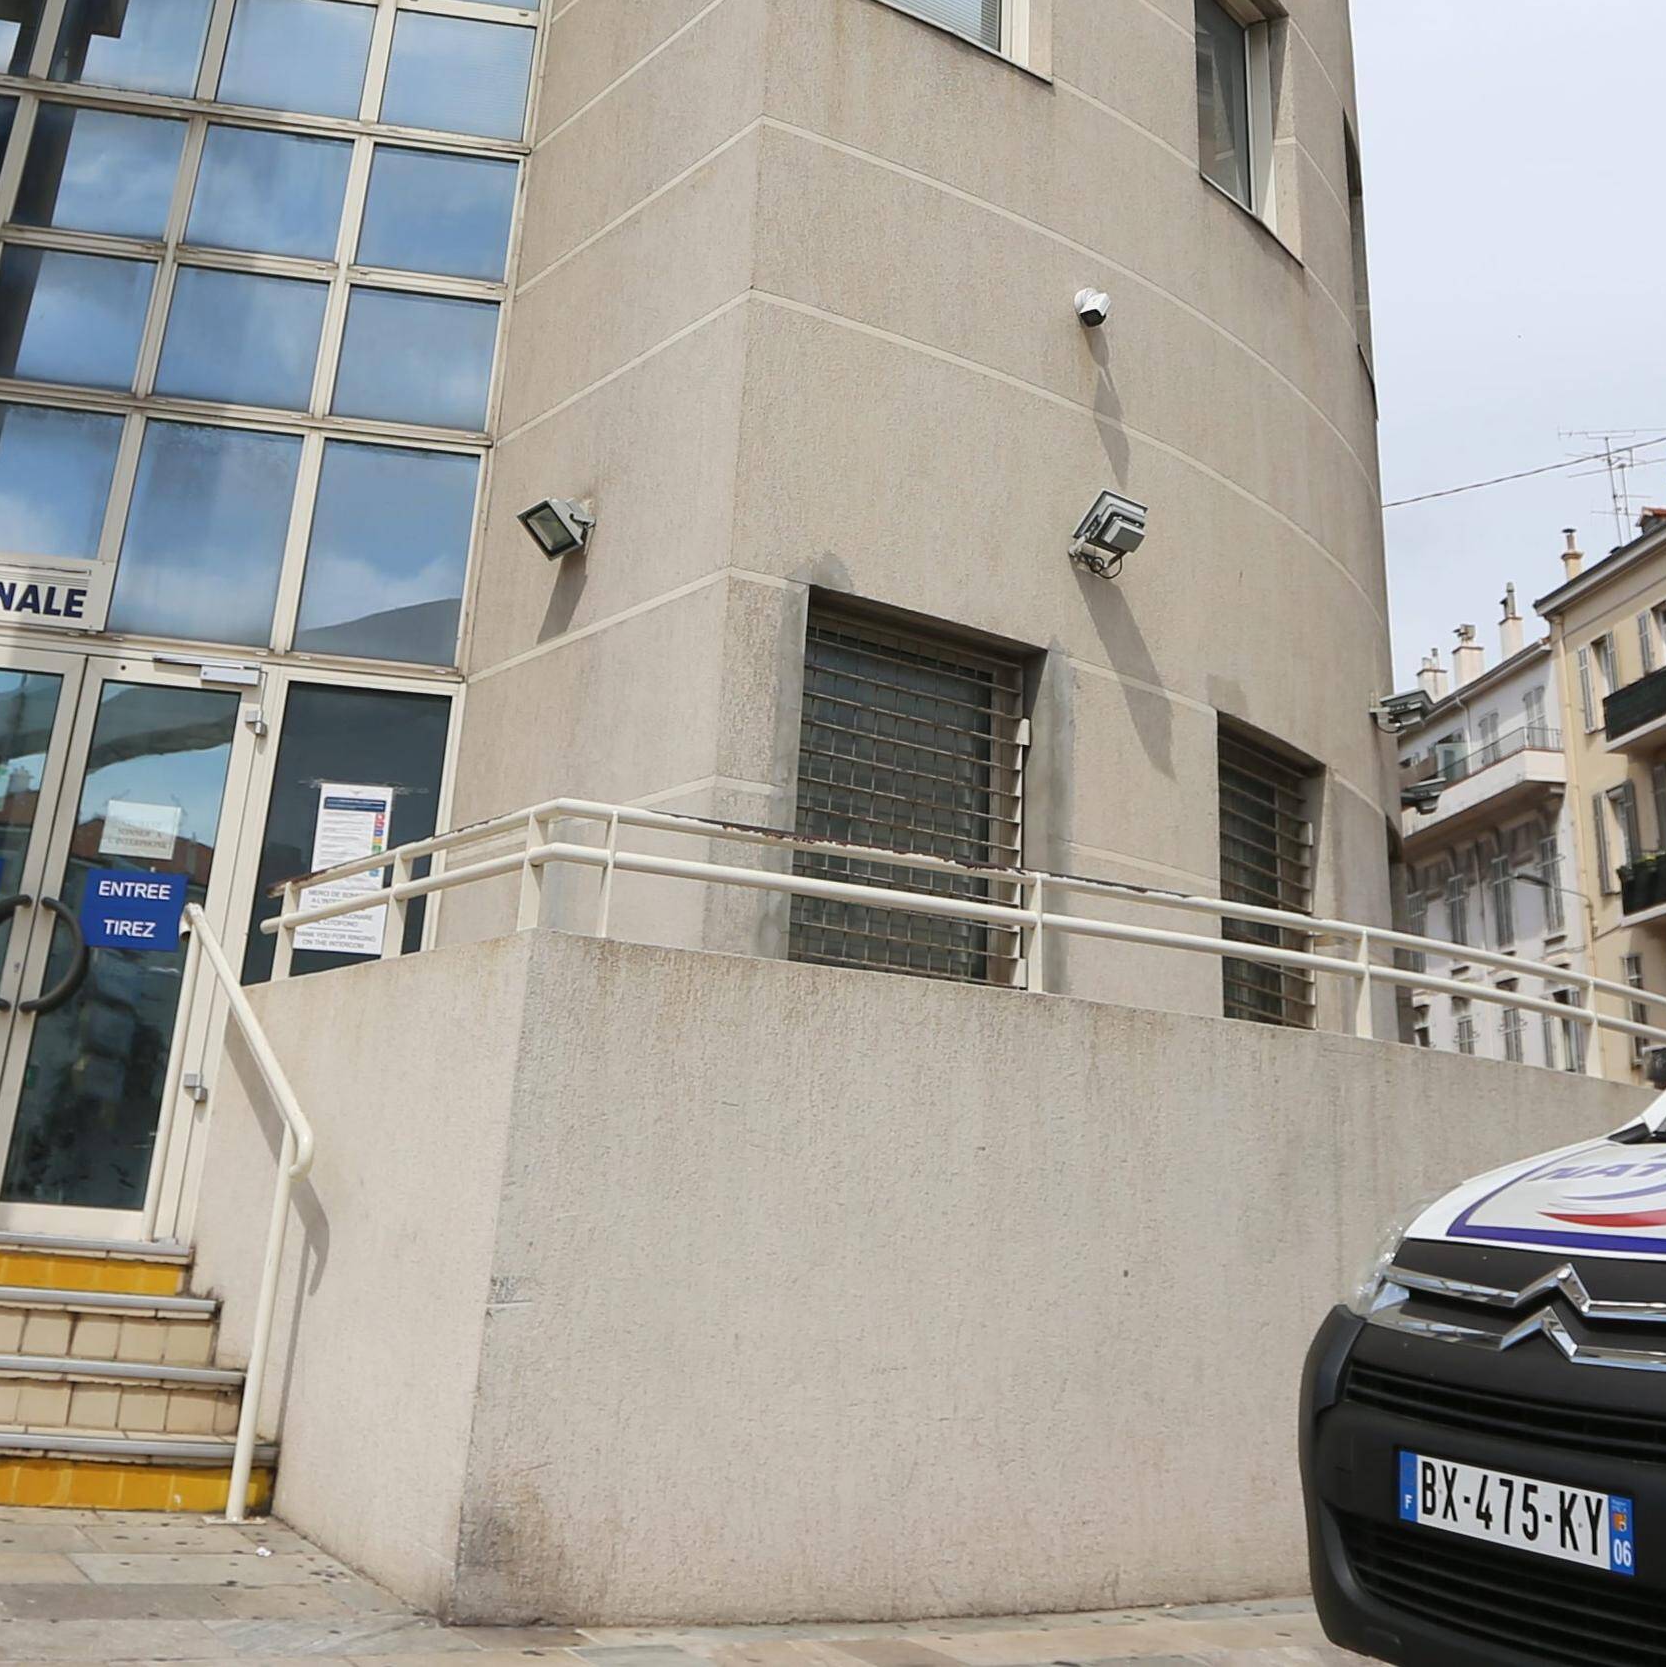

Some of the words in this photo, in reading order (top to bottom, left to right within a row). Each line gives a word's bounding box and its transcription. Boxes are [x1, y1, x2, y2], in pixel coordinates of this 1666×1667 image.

[98, 880, 172, 901] ENTREE
[103, 919, 157, 938] TIREZ
[1405, 1494, 1413, 1510] F
[1421, 1460, 1604, 1557] BX-475-KY
[1613, 1538, 1632, 1567] 06
